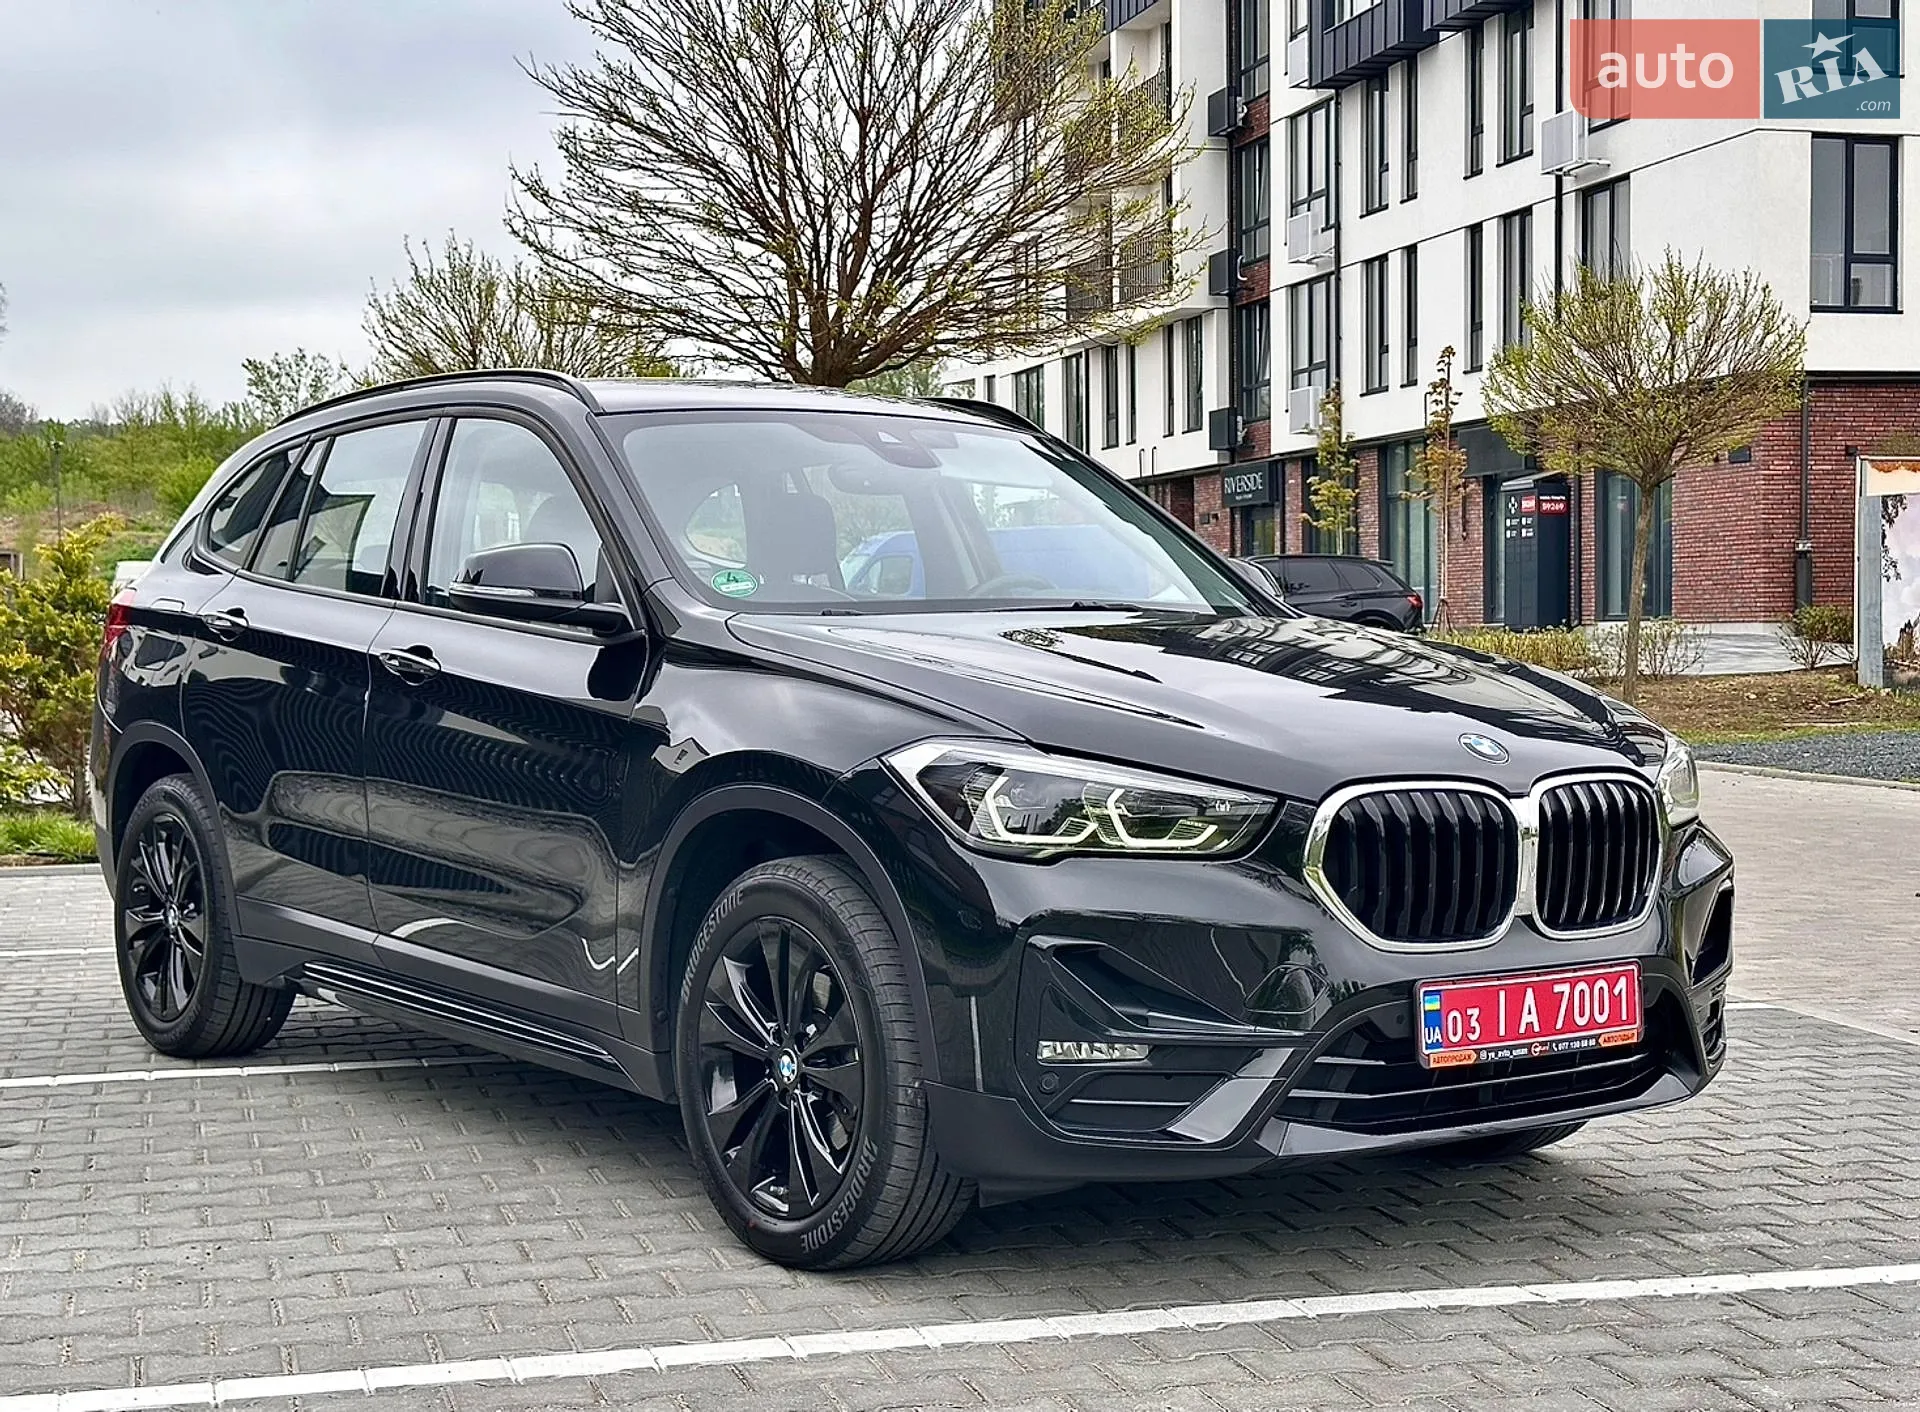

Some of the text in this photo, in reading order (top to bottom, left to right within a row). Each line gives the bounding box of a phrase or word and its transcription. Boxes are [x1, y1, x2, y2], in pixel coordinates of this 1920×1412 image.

[1224, 472, 1264, 495] RIVERSIDE
[680, 887, 744, 1005] BRIDGESTONE
[1424, 1026, 1443, 1044] UA
[1446, 1007, 1481, 1043] 03
[1552, 975, 1628, 1030] 7001
[800, 1135, 879, 1254] BRIDGESTONE
